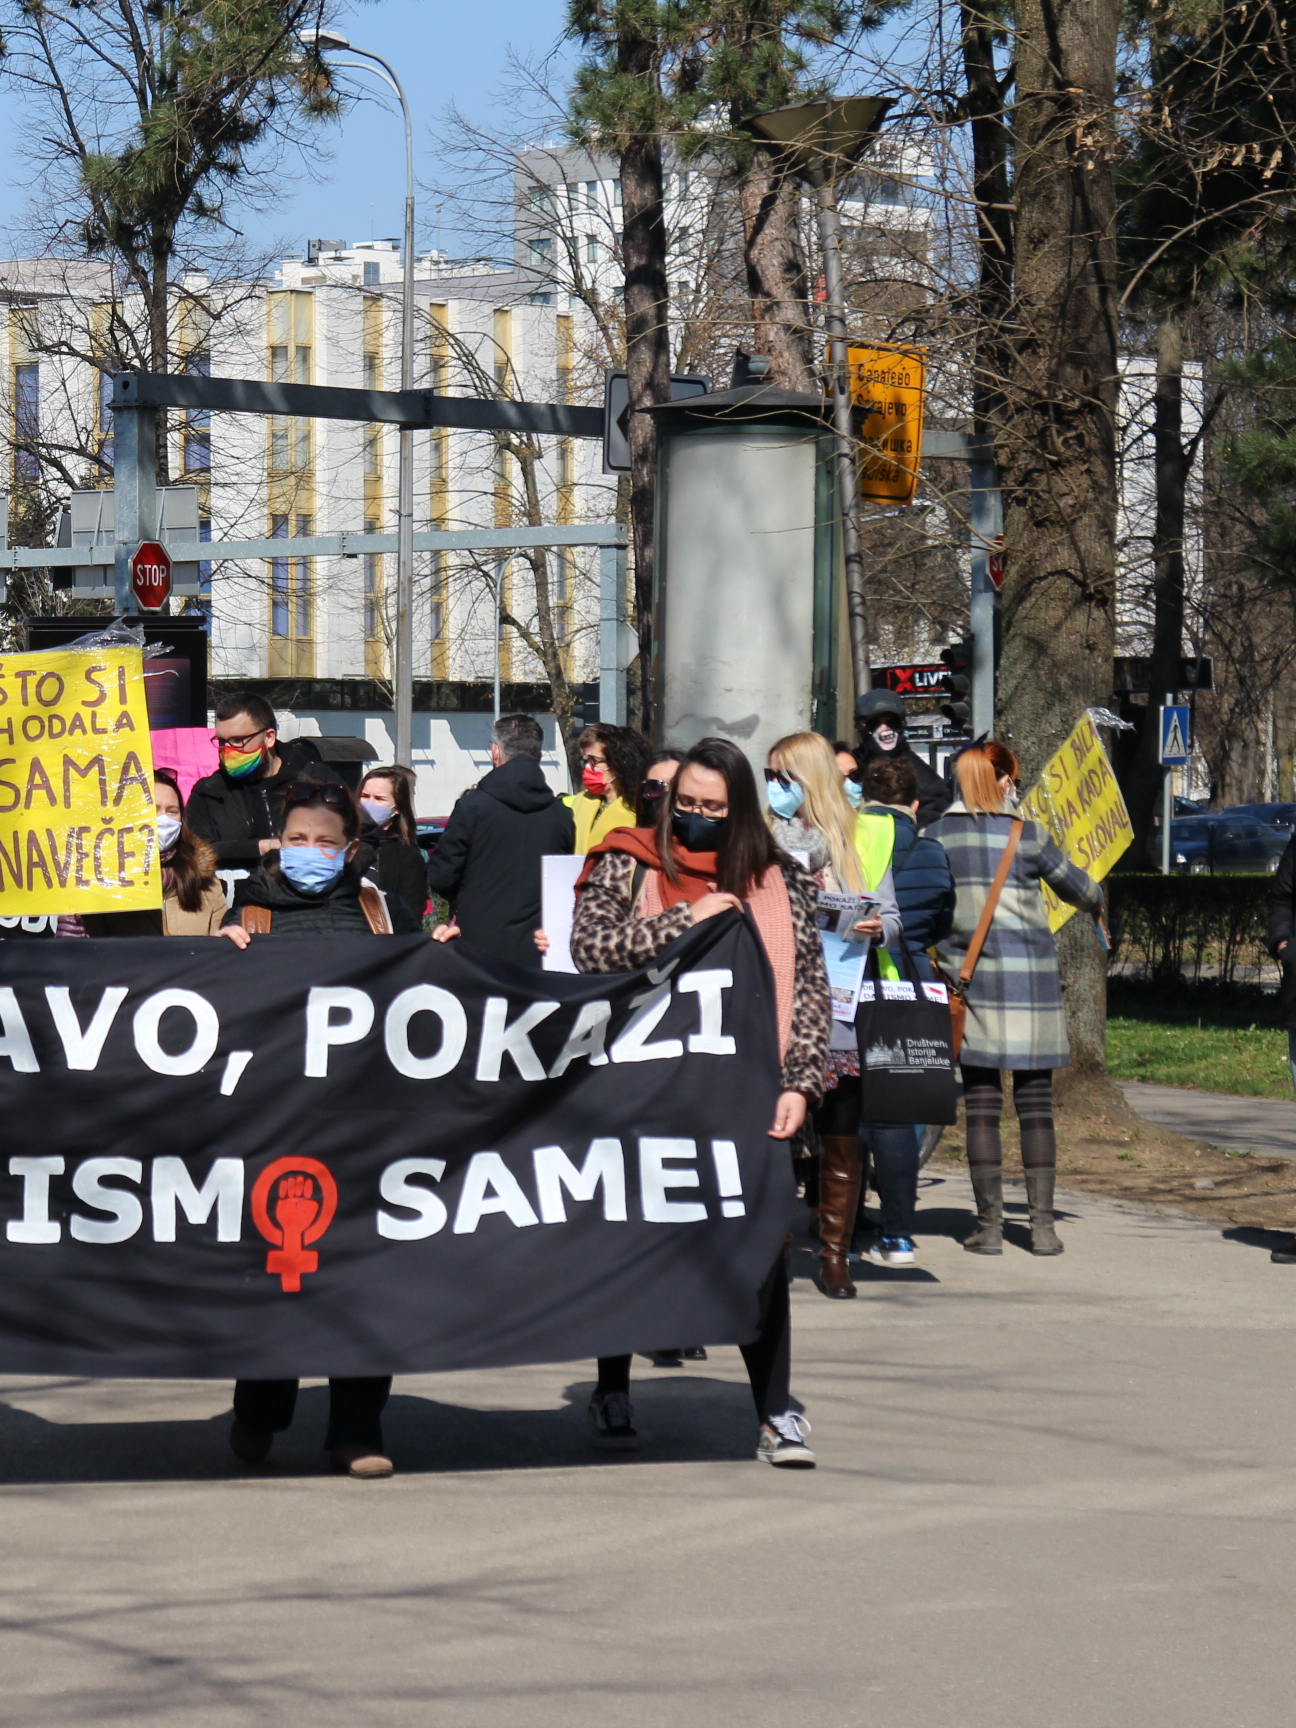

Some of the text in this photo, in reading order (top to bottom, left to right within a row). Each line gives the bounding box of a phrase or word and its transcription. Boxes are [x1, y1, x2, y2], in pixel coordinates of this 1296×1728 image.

[857, 394, 907, 419] Srajevo
[137, 564, 167, 586] STOP
[81, 665, 128, 708] SI
[304, 957, 737, 1082] POKAŽI
[909, 1056, 951, 1067] Banjaluke
[377, 1136, 746, 1241] SAME!
